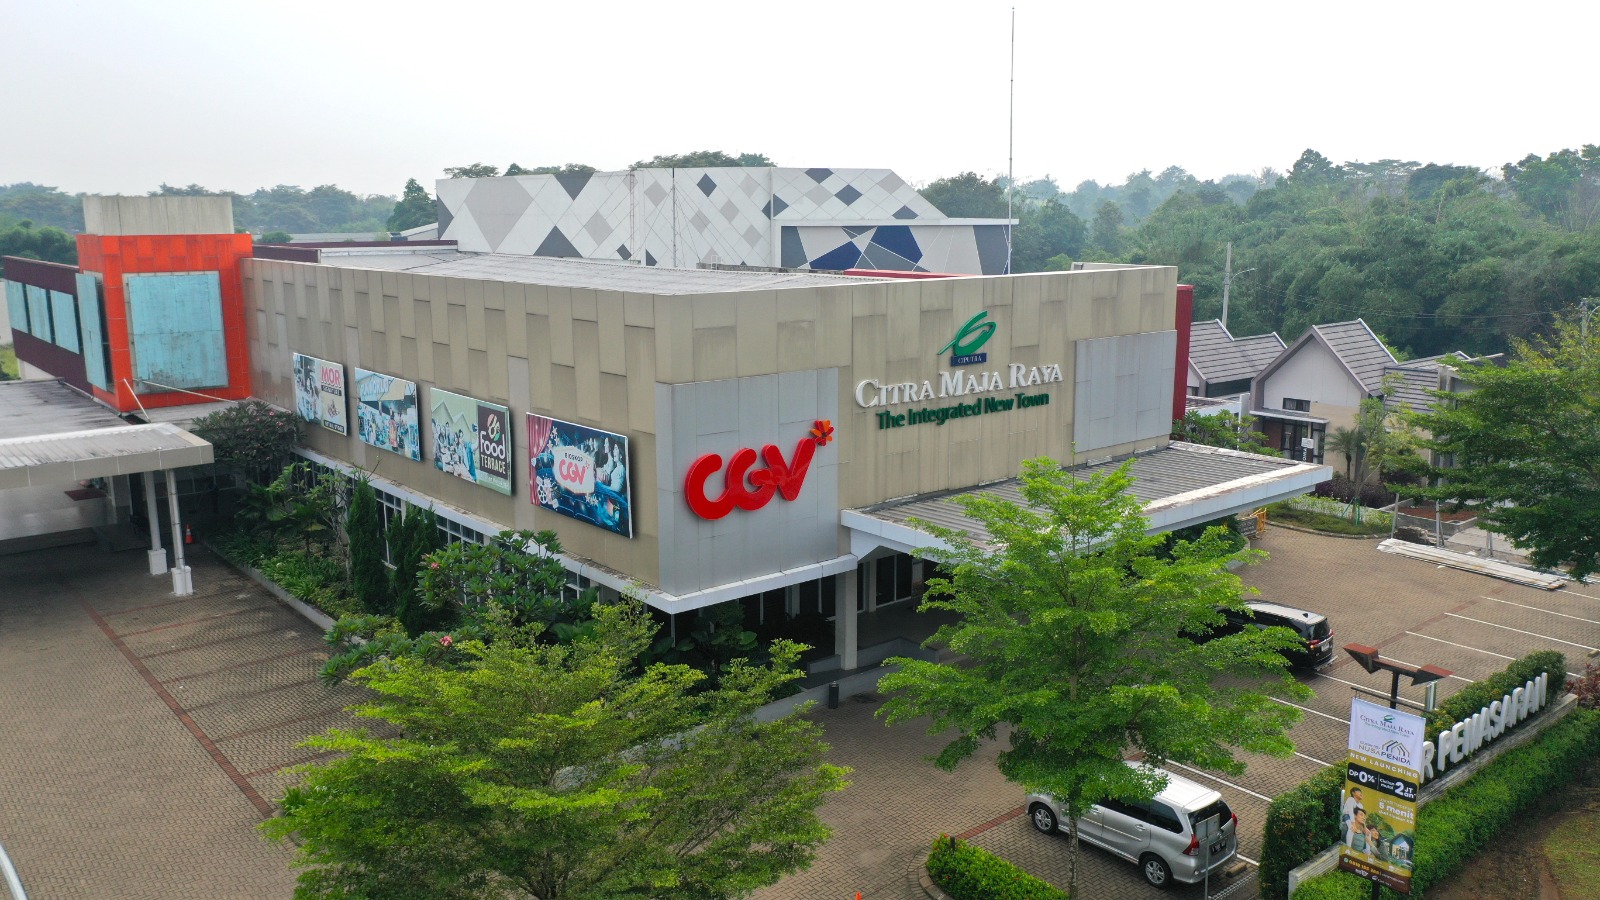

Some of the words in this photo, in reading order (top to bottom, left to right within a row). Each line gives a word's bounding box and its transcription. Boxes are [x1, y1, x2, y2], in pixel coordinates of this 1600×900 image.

[321, 366, 342, 387] MOR
[855, 378, 935, 408] CITRA
[938, 369, 1004, 398] MAJA
[1007, 363, 1064, 389] RAYA
[876, 410, 905, 430] The
[908, 398, 982, 425] Integrated
[984, 397, 1015, 415] New
[1015, 392, 1050, 409] Town
[480, 430, 506, 460] Food
[480, 454, 506, 474] TERRACE
[559, 459, 586, 485] CGV
[684, 437, 818, 521] CGV
[1350, 752, 1367, 762] NEW
[1369, 759, 1418, 779] LAUNCHING
